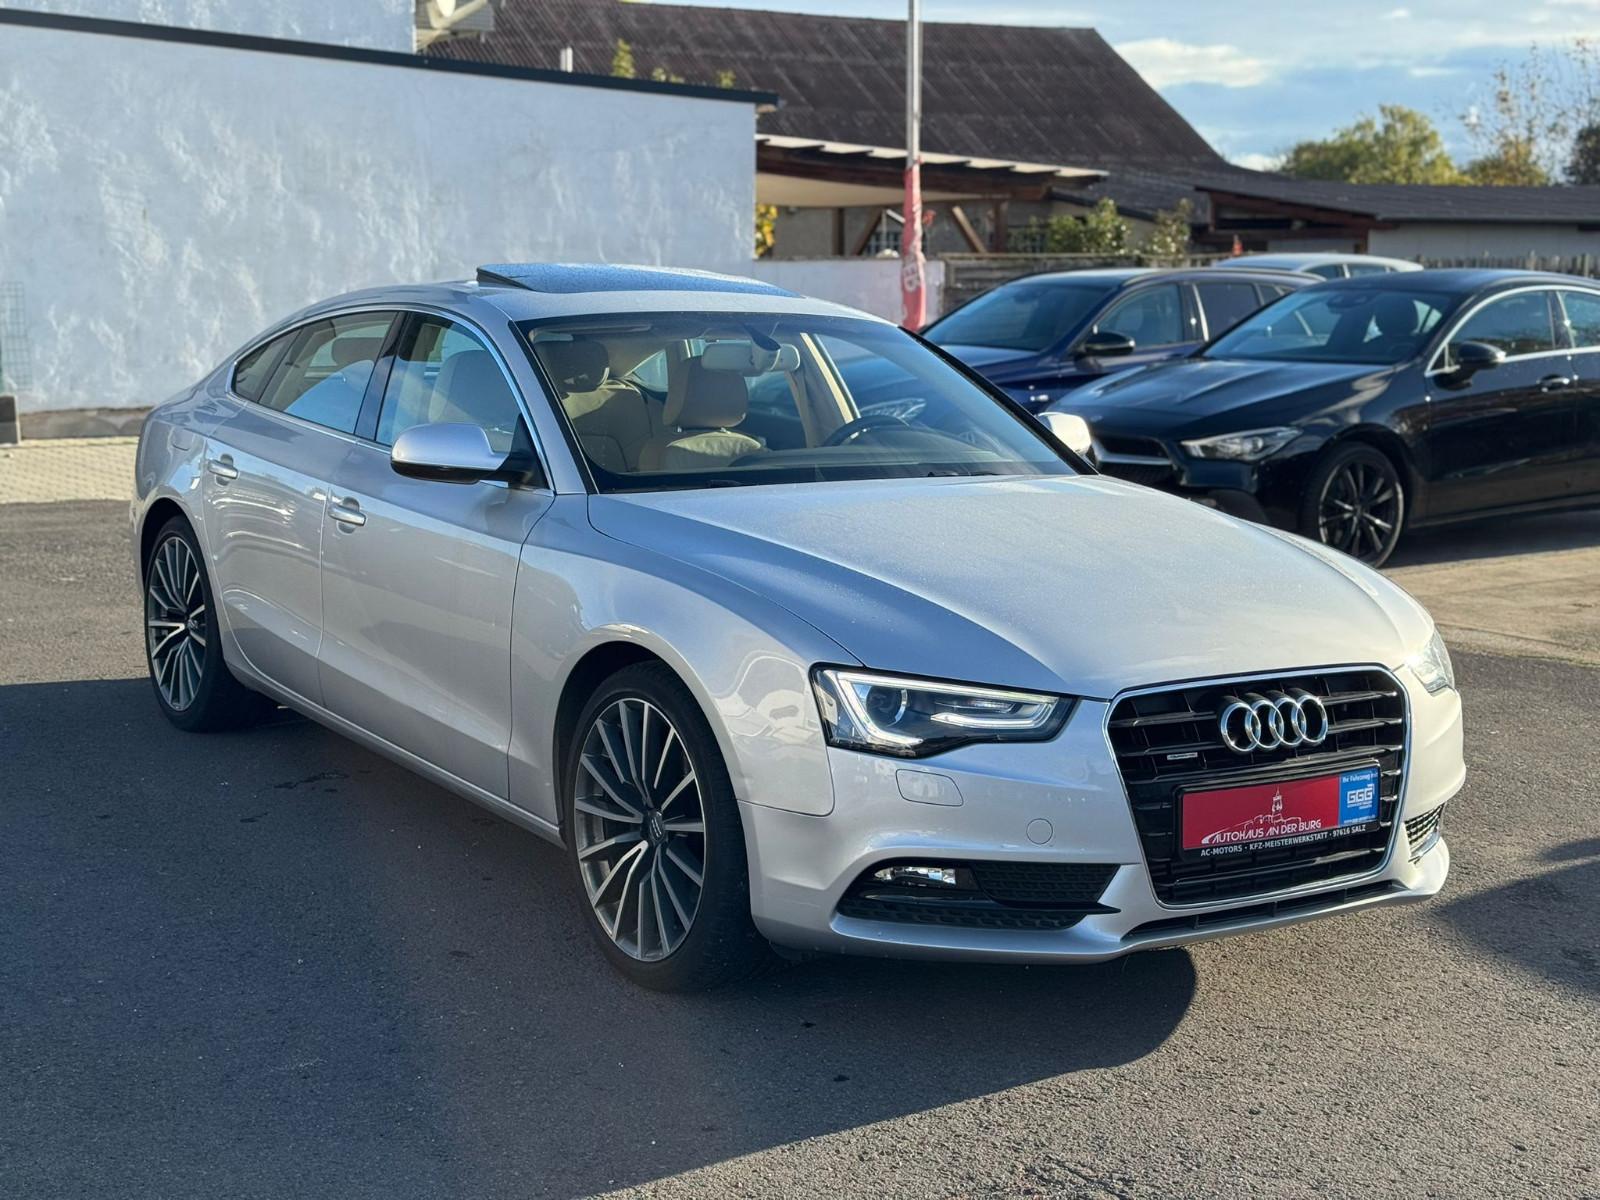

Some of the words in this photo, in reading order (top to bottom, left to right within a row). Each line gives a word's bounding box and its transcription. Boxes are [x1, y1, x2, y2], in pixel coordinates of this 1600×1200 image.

[1200, 845, 1243, 856] AC-MOTORS
[1249, 832, 1328, 850] KFZ-MEISTERWERKSTATT
[1332, 828, 1351, 838] 97616
[1351, 824, 1366, 834] SALZ
[1212, 829, 1264, 844] AUTOHAUS
[1266, 826, 1280, 837] AN
[1281, 823, 1298, 835] DER
[1299, 819, 1322, 831] BURG
